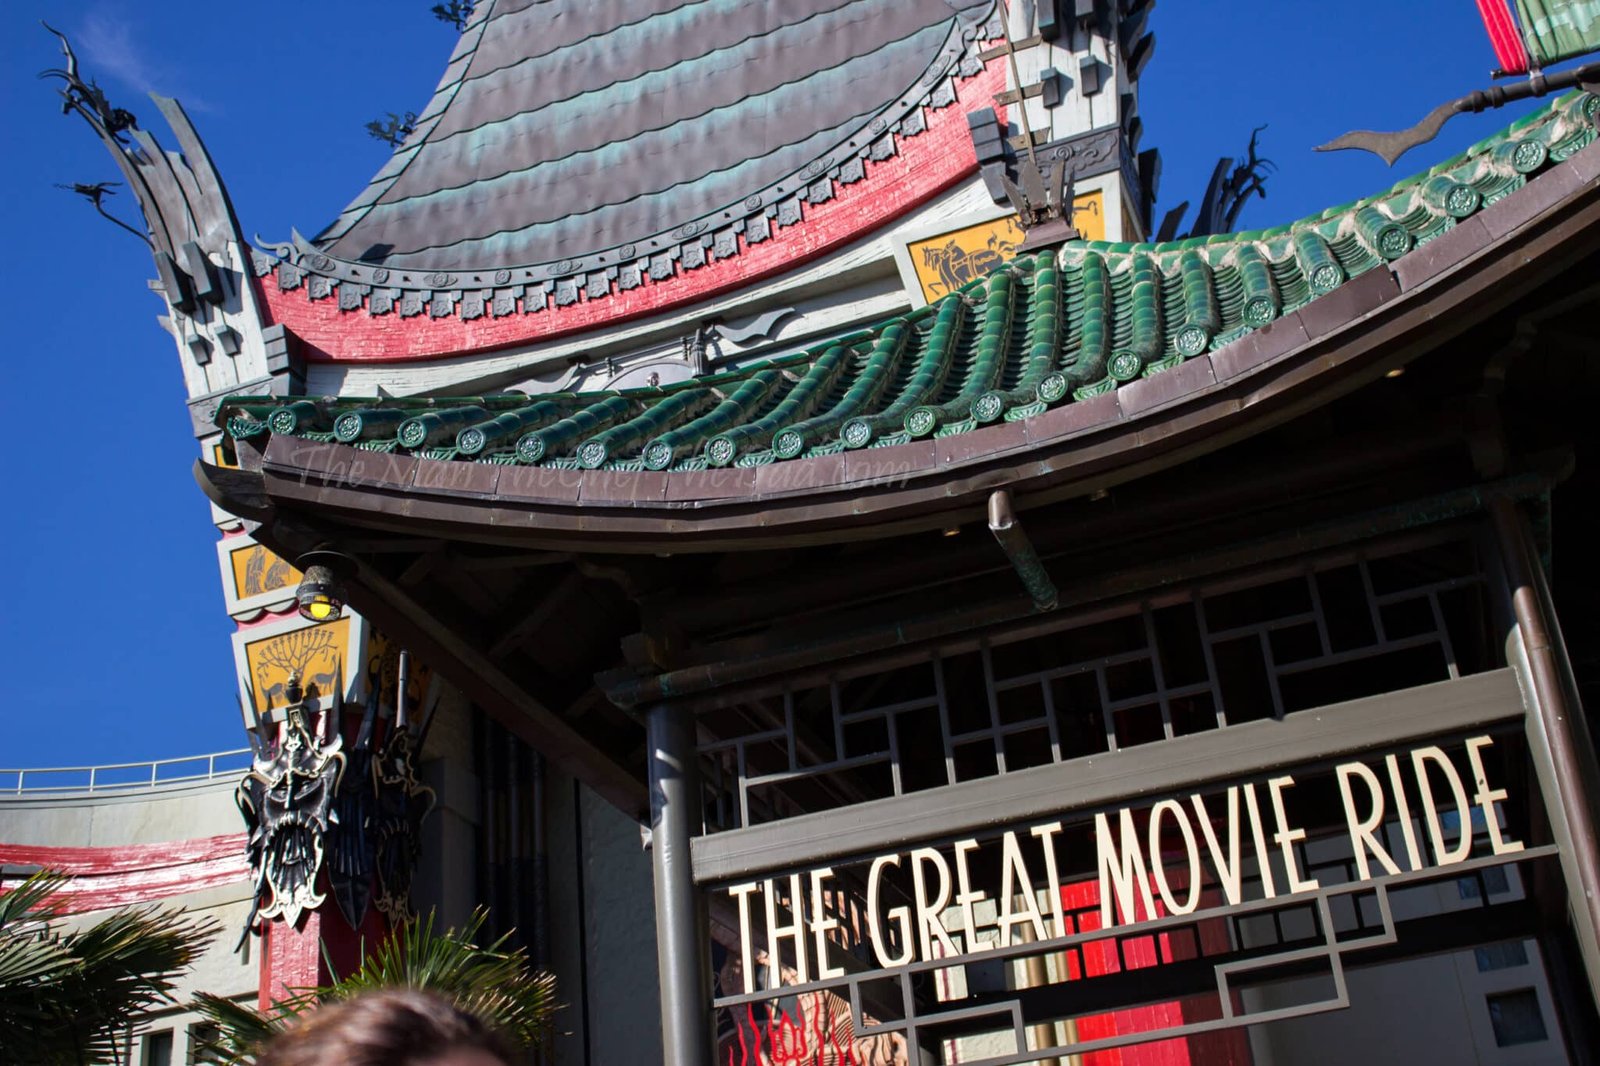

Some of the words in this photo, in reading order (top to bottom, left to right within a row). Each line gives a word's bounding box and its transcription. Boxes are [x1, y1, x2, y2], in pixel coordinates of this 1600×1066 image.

[728, 867, 845, 994] THE
[867, 821, 1066, 968] GREAT
[1095, 775, 1319, 929] MOVIE
[1336, 735, 1525, 880] RIDE
